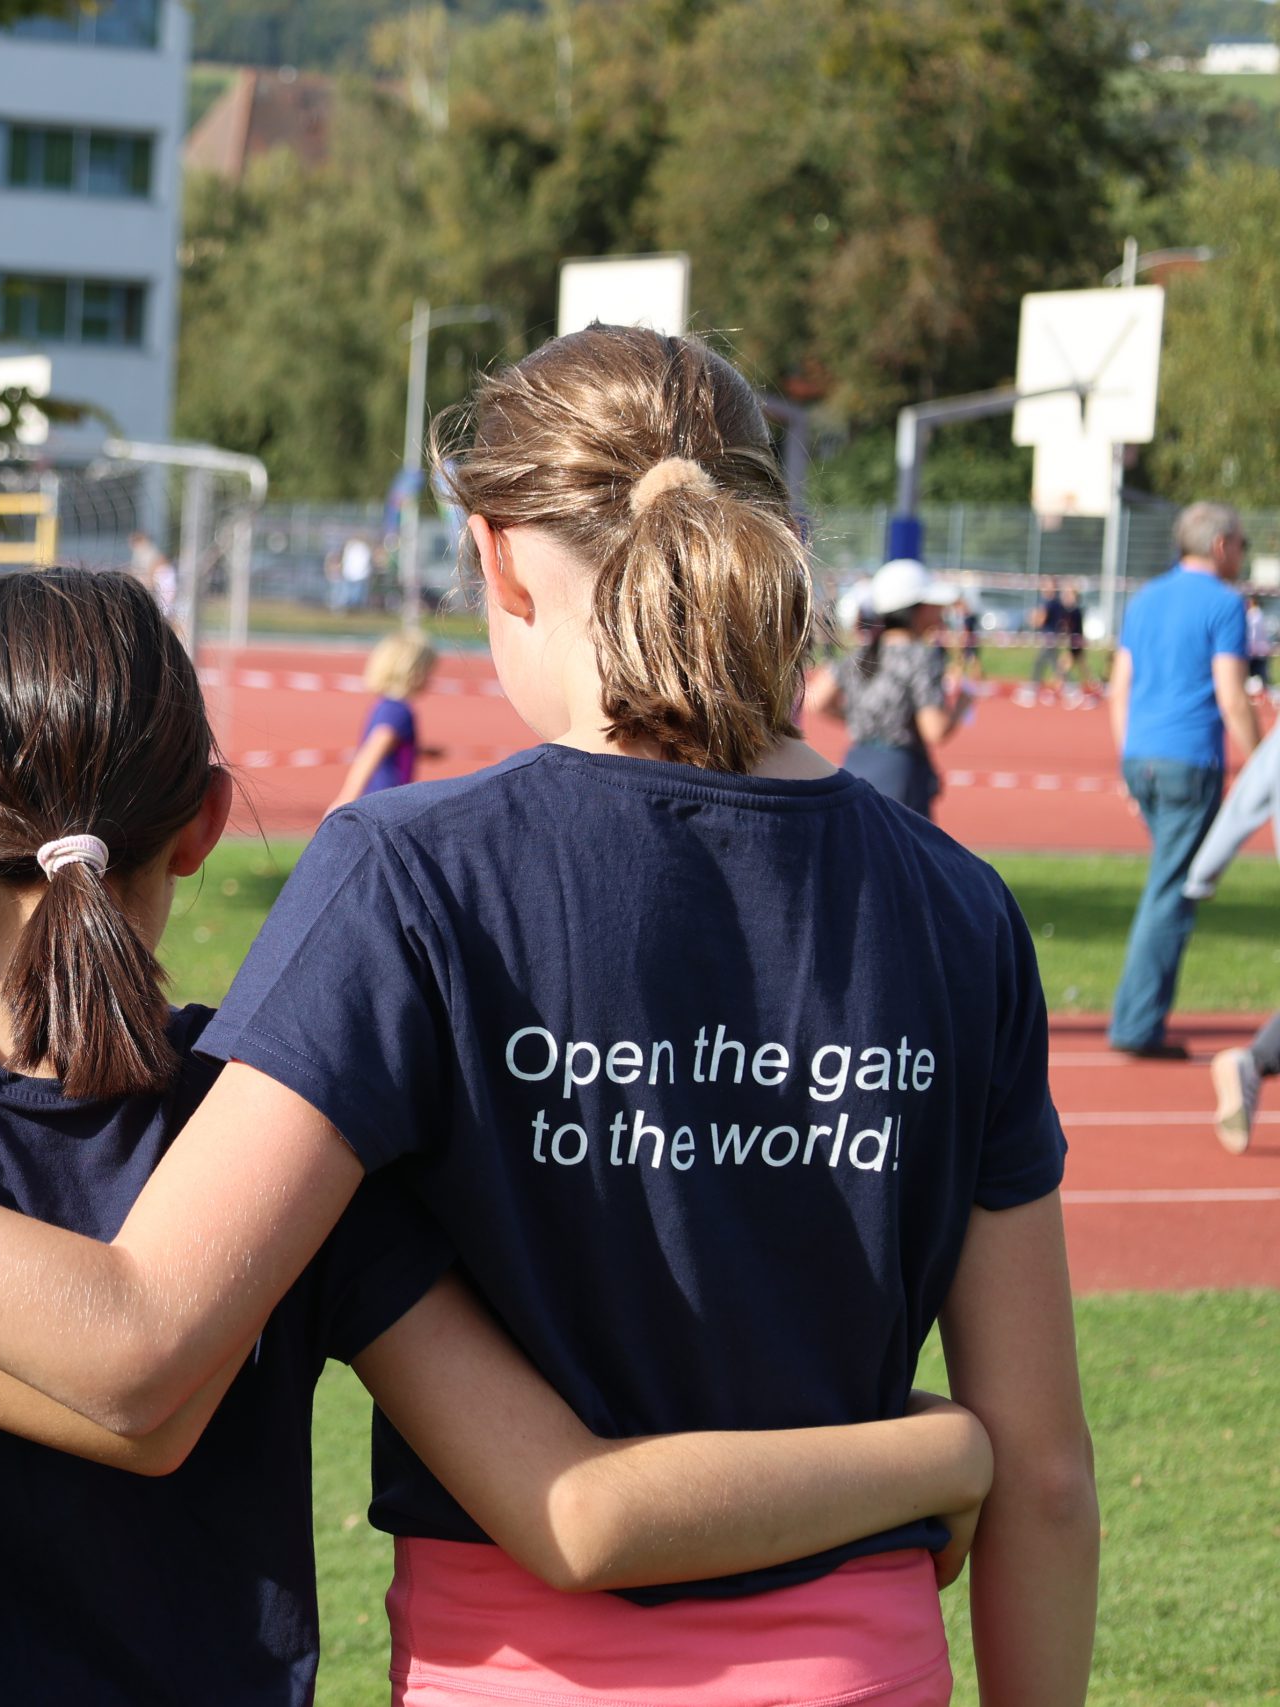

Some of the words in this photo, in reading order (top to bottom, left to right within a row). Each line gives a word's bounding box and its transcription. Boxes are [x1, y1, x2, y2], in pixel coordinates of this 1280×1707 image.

[505, 1026, 675, 1099] Open
[693, 1024, 790, 1086] the
[808, 1035, 936, 1103] gate
[531, 1109, 589, 1166] to
[609, 1109, 696, 1171] the
[710, 1112, 902, 1173] world!
